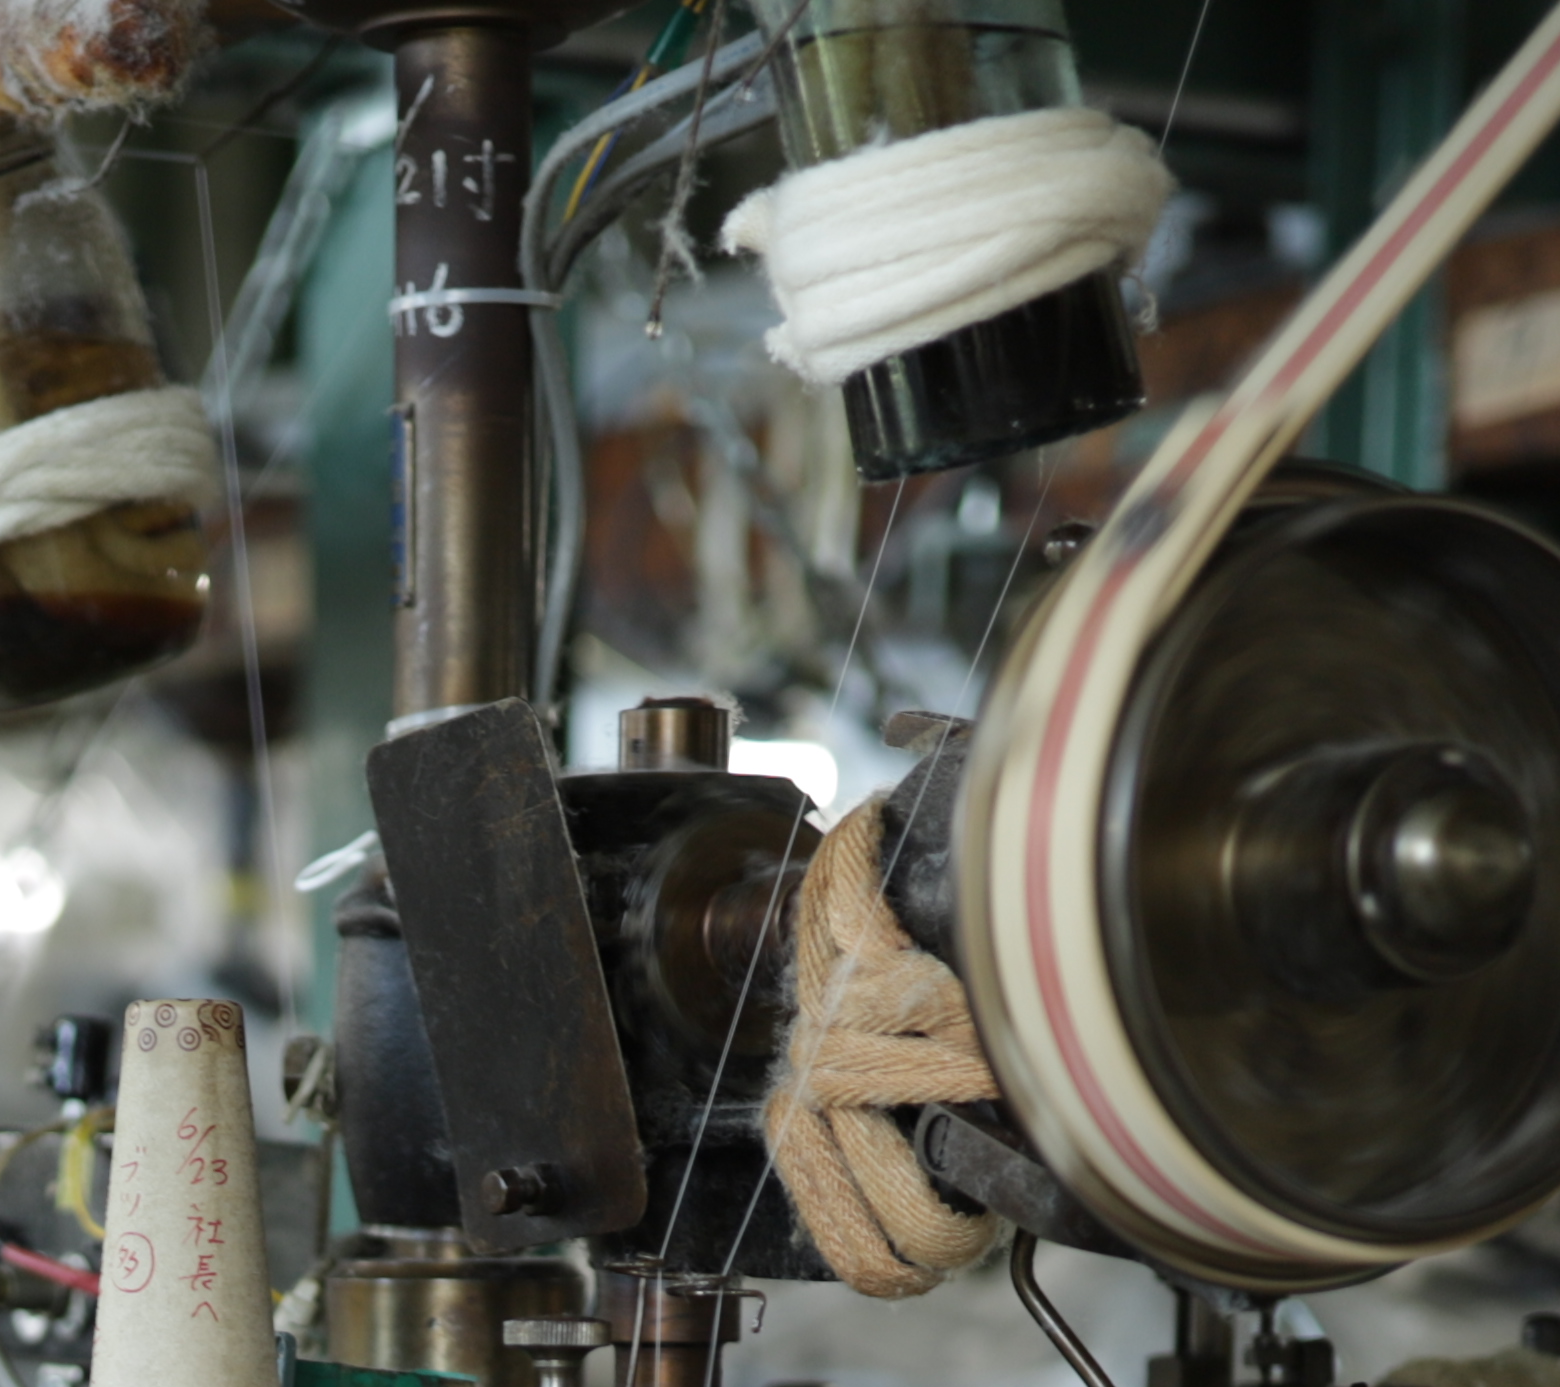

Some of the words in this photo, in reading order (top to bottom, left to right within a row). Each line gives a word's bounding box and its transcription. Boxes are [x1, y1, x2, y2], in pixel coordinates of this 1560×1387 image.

[177, 1107, 229, 1185] 6/23
[180, 1204, 226, 1322] 社長へ
